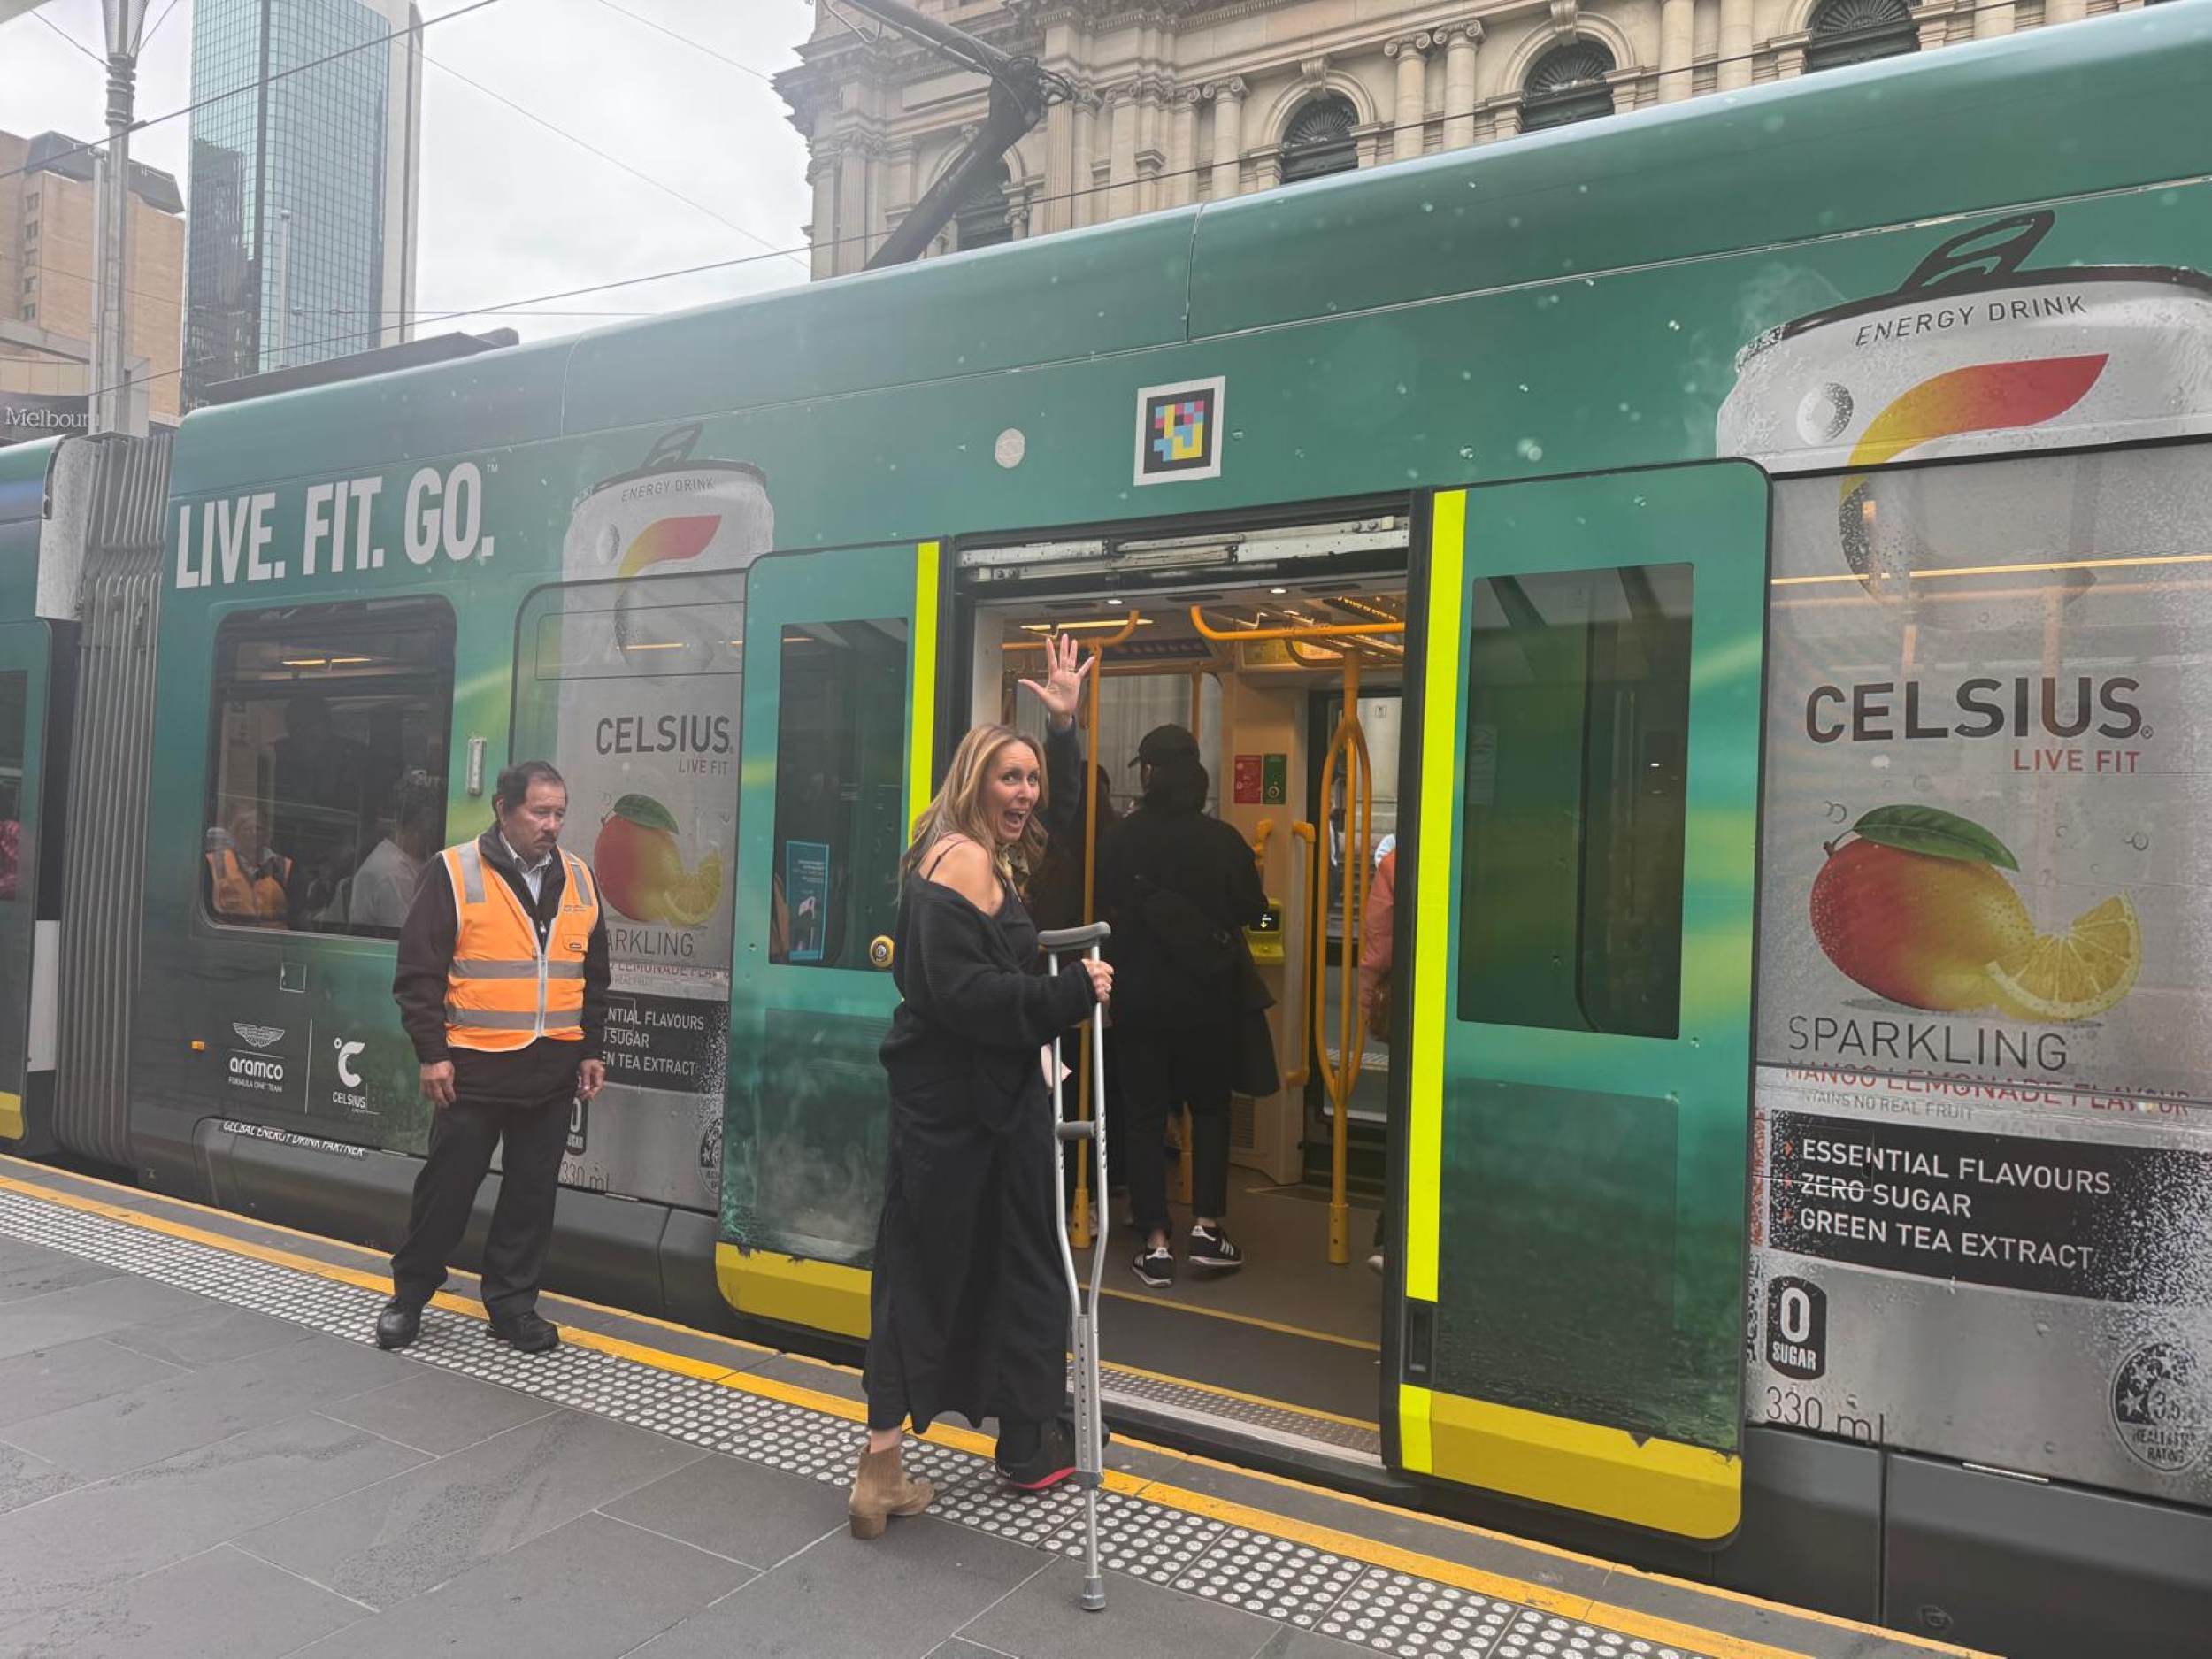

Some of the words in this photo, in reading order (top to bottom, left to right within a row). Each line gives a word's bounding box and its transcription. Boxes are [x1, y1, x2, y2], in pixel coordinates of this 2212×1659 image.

[1855, 306, 1974, 347] ENERGY
[1989, 296, 2089, 322] DRINK
[5, 407, 88, 427] Melbour
[621, 480, 670, 503] ENERGY
[675, 478, 716, 492] DRINK
[176, 492, 286, 589] LIVE.
[303, 475, 385, 575] FIT.
[404, 462, 495, 565] GO.
[679, 759, 707, 773] LIVE
[711, 761, 729, 775] FIT
[2014, 749, 2084, 772] LIVE
[2096, 749, 2141, 773] FIT
[607, 928, 694, 957] ARKLING
[608, 1007, 641, 1025] NTIAL
[644, 1011, 704, 1031] FLAVOURS
[610, 1030, 650, 1048] SUGAR
[1789, 1016, 2068, 1072] SPARKLING
[230, 1056, 284, 1080] aramco
[619, 1052, 641, 1071] TEA
[644, 1056, 695, 1076] EXTRACT
[332, 1091, 365, 1108] CELSIUS
[1888, 1068, 2062, 1105] LEMONADE
[1880, 1098, 1921, 1115] REAL
[1925, 1102, 1975, 1120] FRUIT
[562, 1160, 585, 1187] 330
[1803, 1139, 1950, 1179] ESSENTIAL
[1959, 1157, 2111, 1195] FLAVOURS
[1801, 1173, 1865, 1203] ZERO
[1873, 1184, 1972, 1218] SUGAR
[1801, 1208, 1886, 1243] GREEN
[1896, 1223, 1951, 1253] TEA
[1962, 1233, 2093, 1270] EXTRACT
[1780, 1287, 1810, 1343] 0
[1772, 1341, 1817, 1371] SUGAR
[1766, 1386, 1823, 1431] 330
